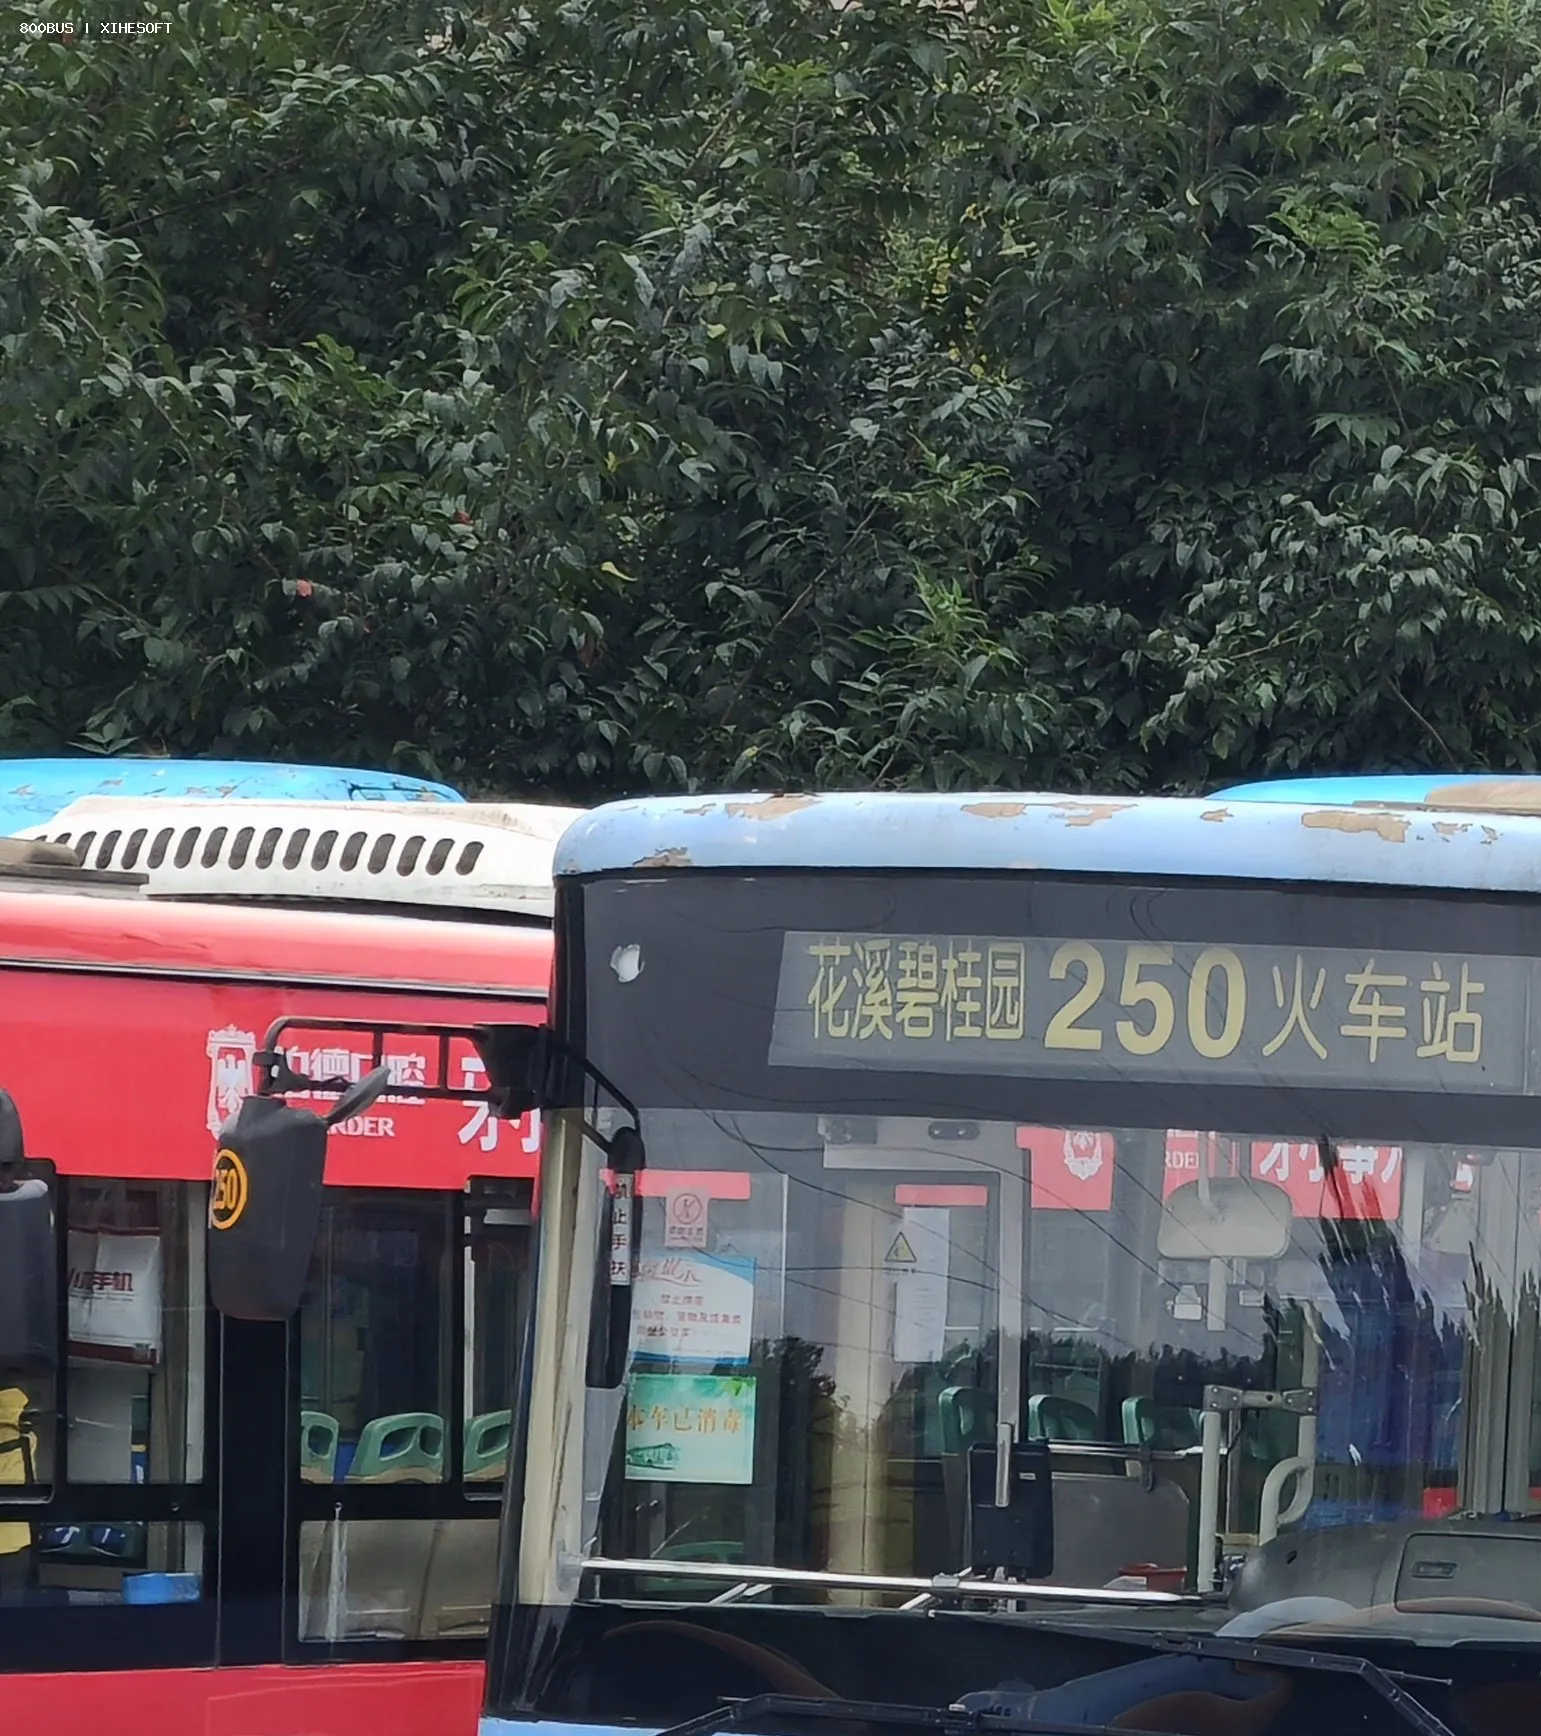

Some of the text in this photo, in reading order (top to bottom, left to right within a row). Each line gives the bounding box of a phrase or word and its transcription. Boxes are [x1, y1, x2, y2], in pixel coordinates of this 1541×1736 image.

[807, 938, 1486, 1064] 花溪碧桂园 250 火车站
